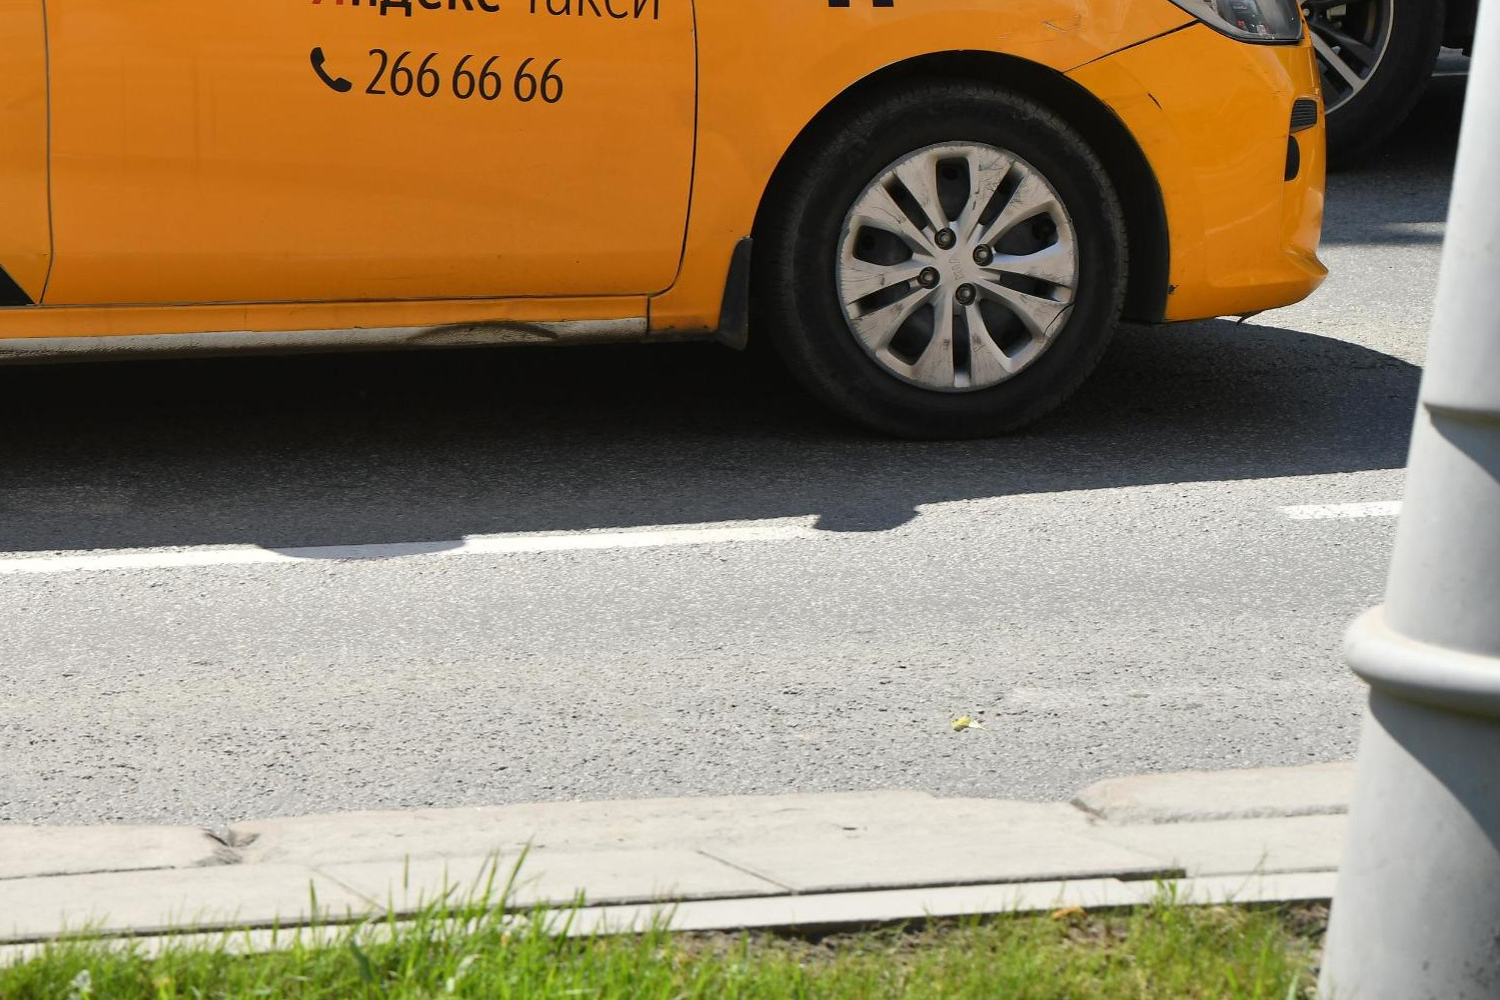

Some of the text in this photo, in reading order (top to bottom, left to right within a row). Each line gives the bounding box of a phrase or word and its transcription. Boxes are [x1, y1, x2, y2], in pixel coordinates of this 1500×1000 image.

[365, 48, 564, 104] 266 66 66
